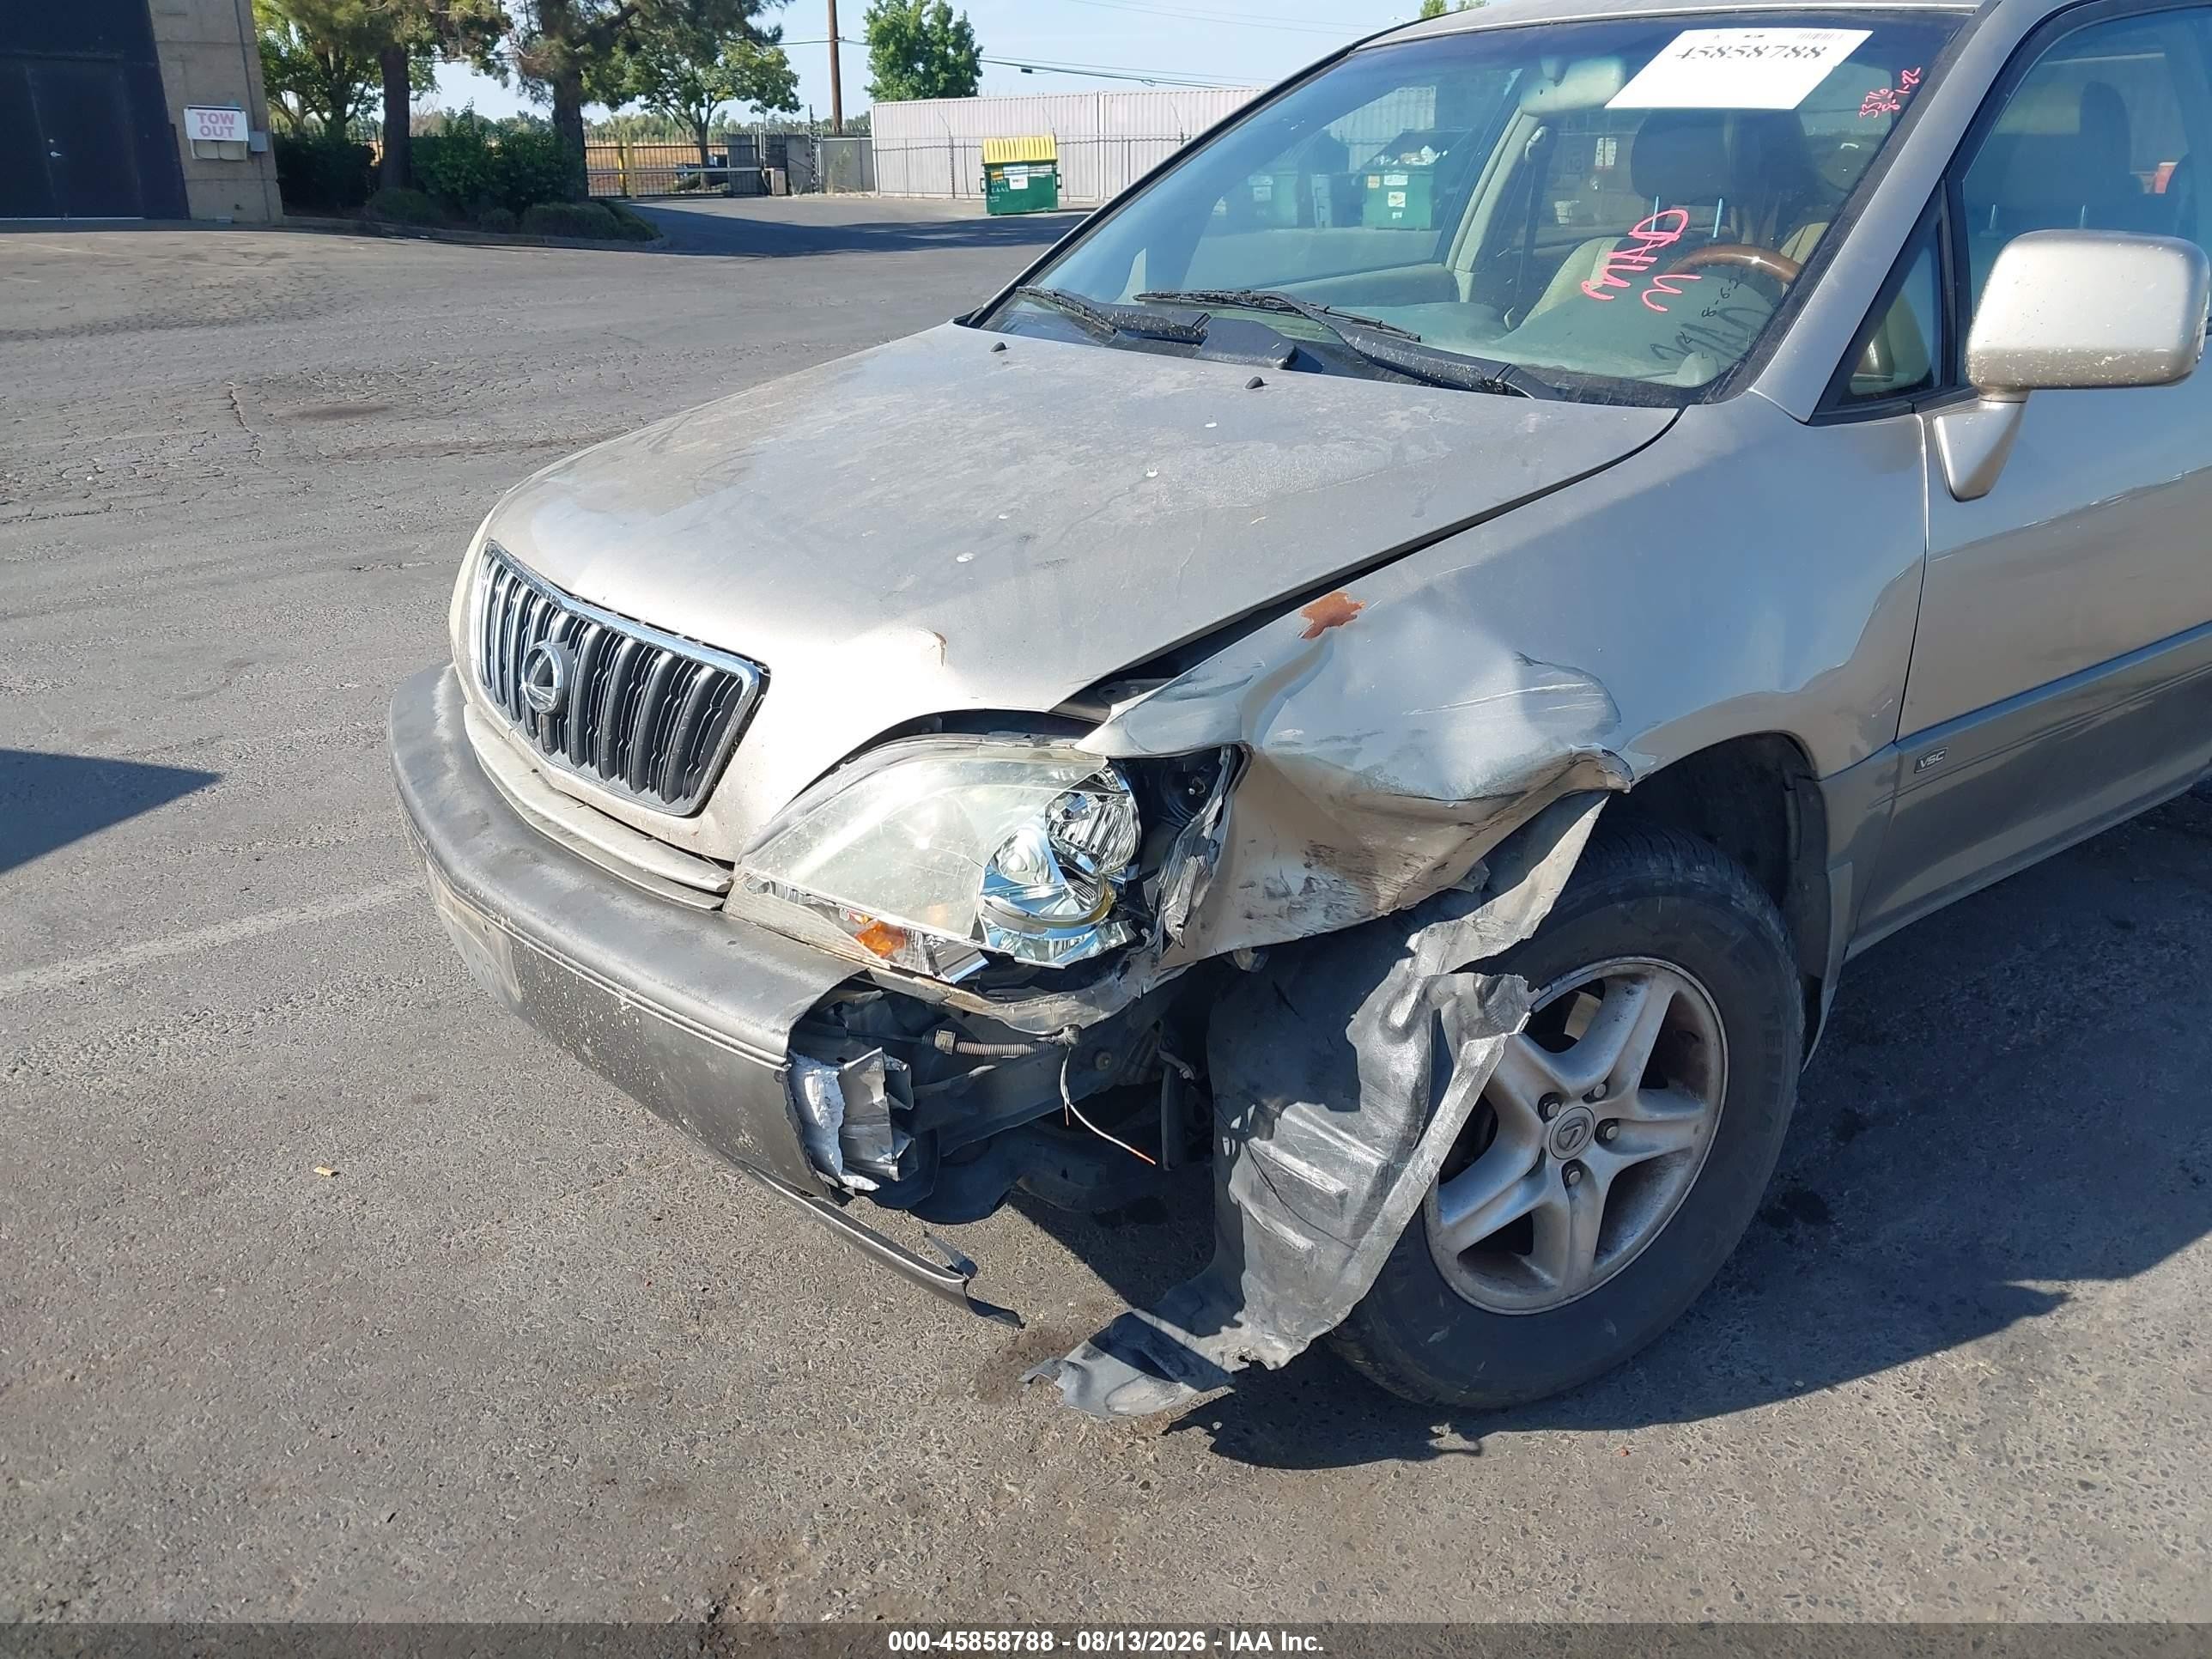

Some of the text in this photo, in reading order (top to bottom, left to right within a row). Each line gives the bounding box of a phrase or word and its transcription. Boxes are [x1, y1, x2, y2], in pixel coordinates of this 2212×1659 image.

[1675, 45, 1827, 59] 45858788
[196, 112, 234, 125] TOW
[199, 125, 234, 137] OUT
[1919, 750, 1946, 769] VSC
